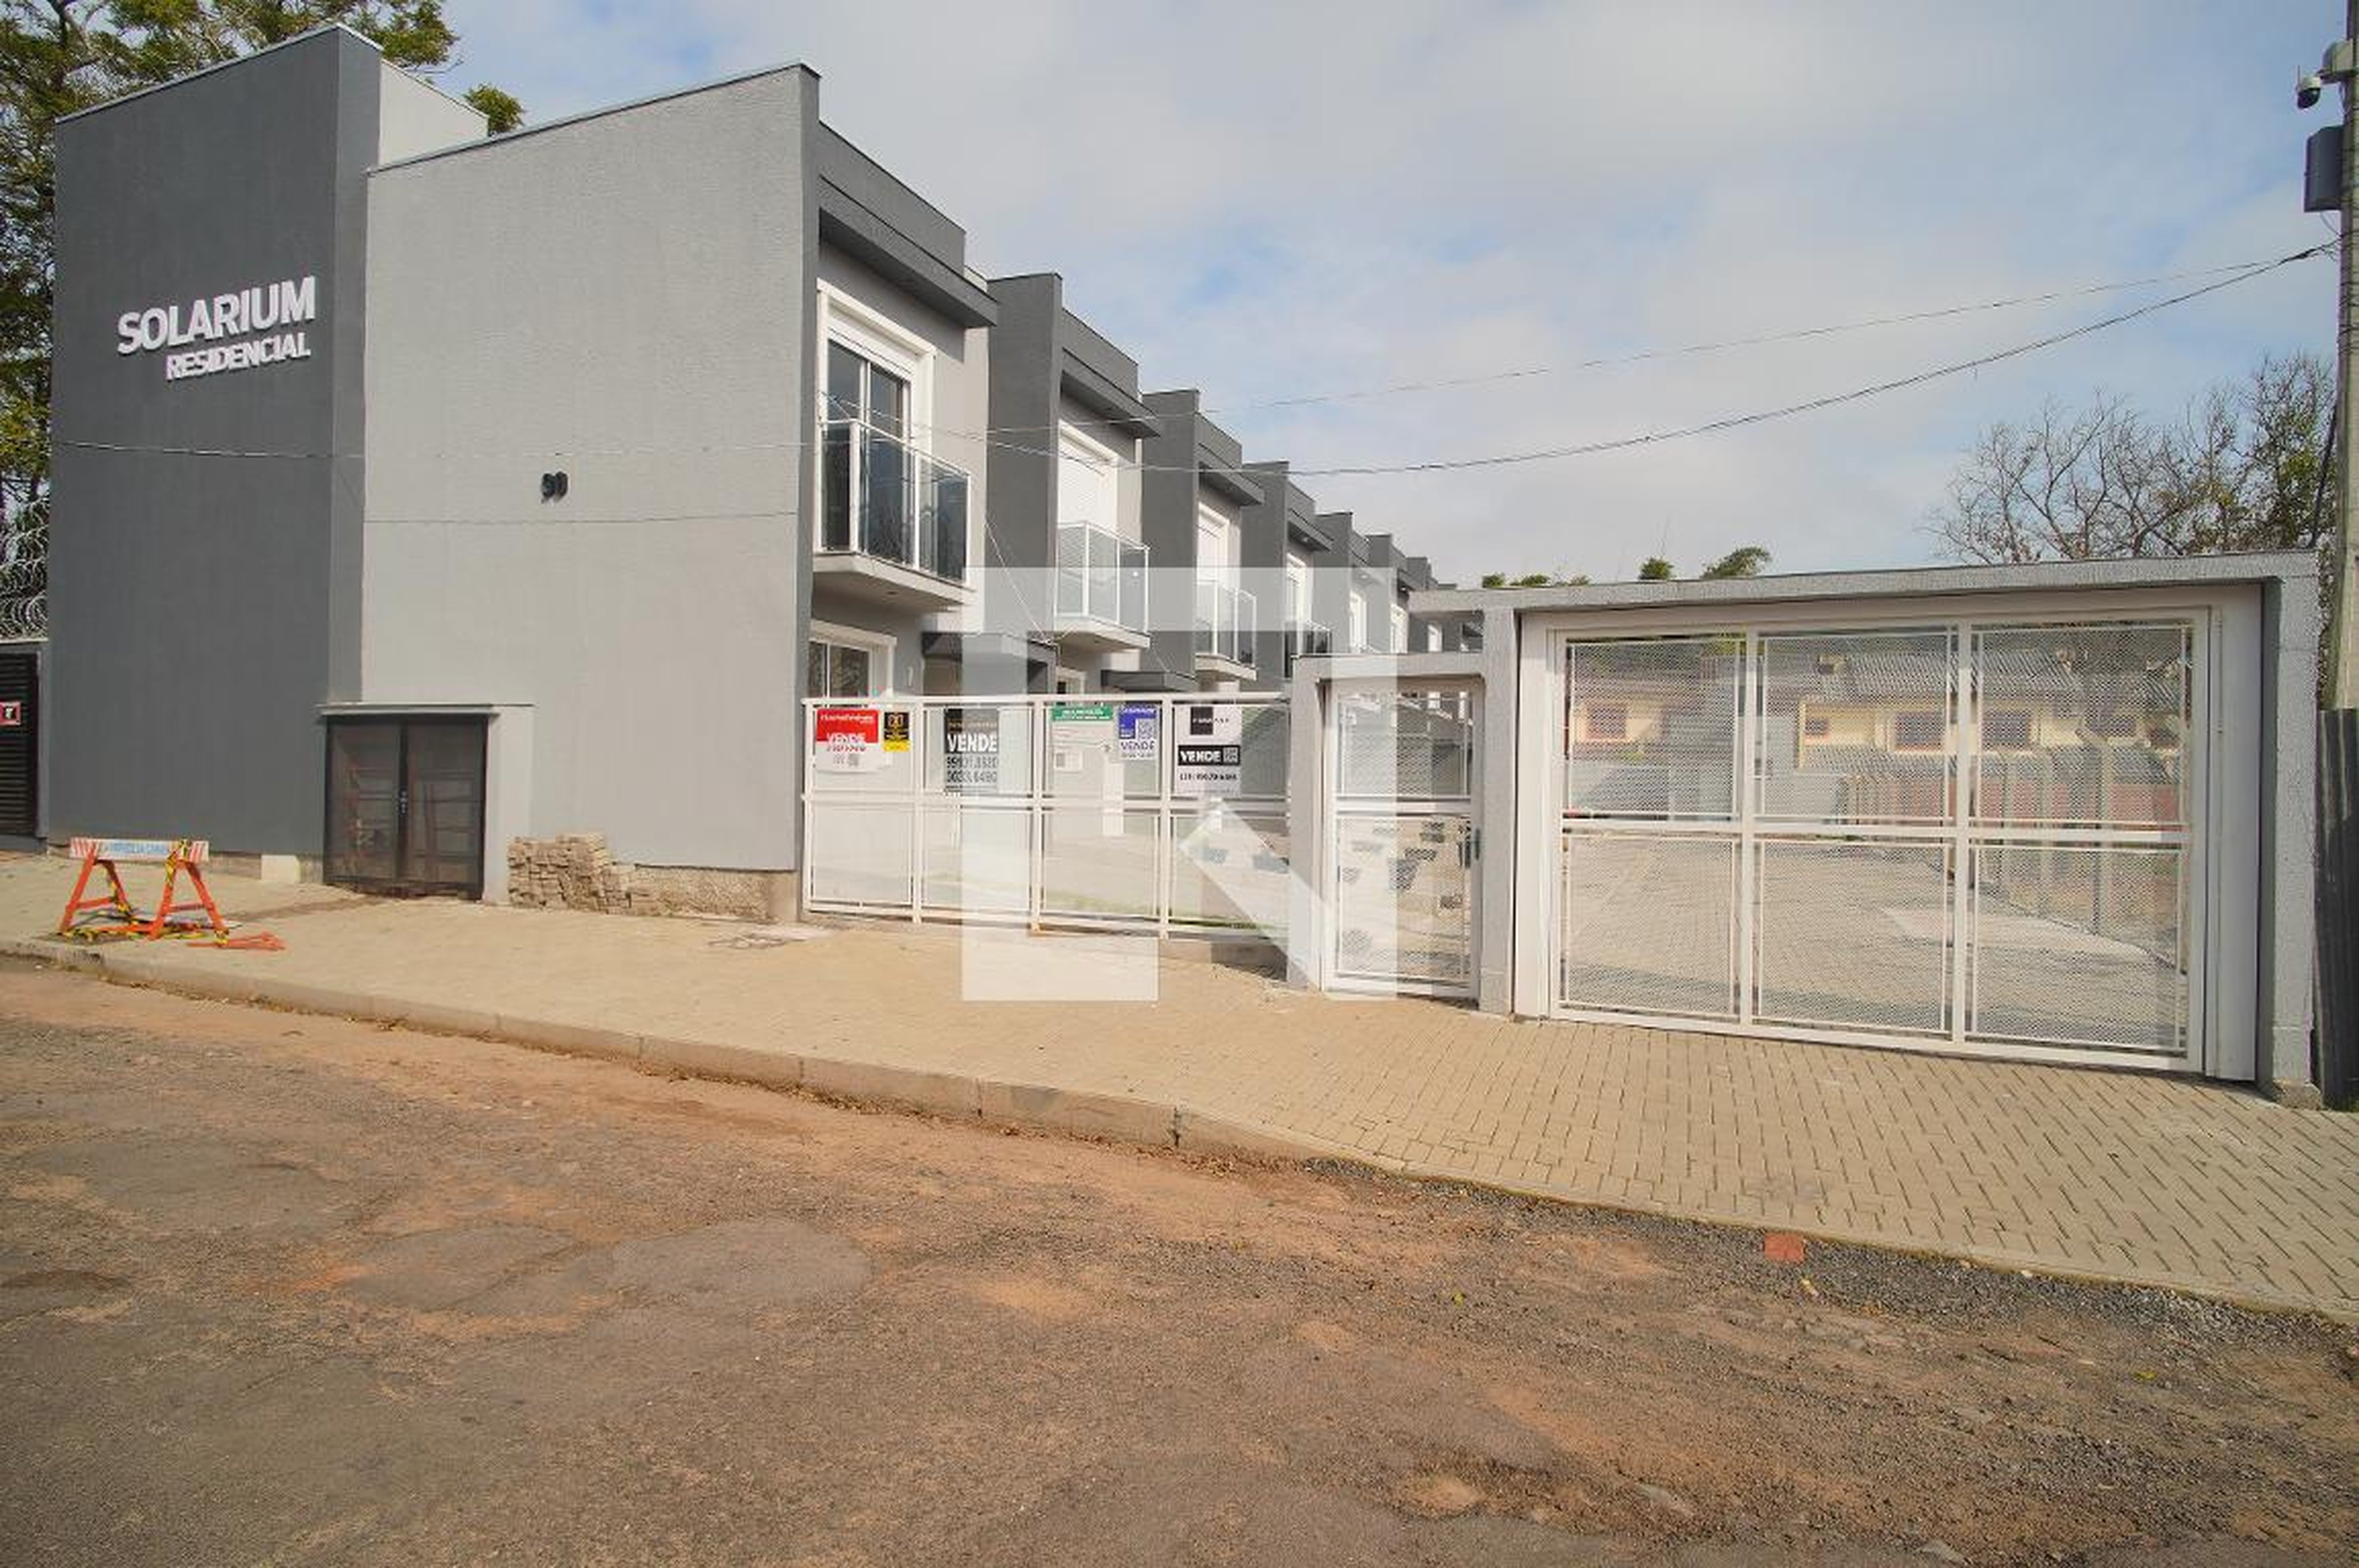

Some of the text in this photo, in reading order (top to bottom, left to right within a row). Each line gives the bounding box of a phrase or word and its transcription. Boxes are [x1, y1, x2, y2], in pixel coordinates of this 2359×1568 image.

[117, 276, 316, 354] SOLARIUM
[166, 332, 311, 380] RESIDENCIAL
[947, 733, 998, 752] VENDE
[1121, 740, 1155, 750] VENDE
[1180, 751, 1221, 762] VENDE
